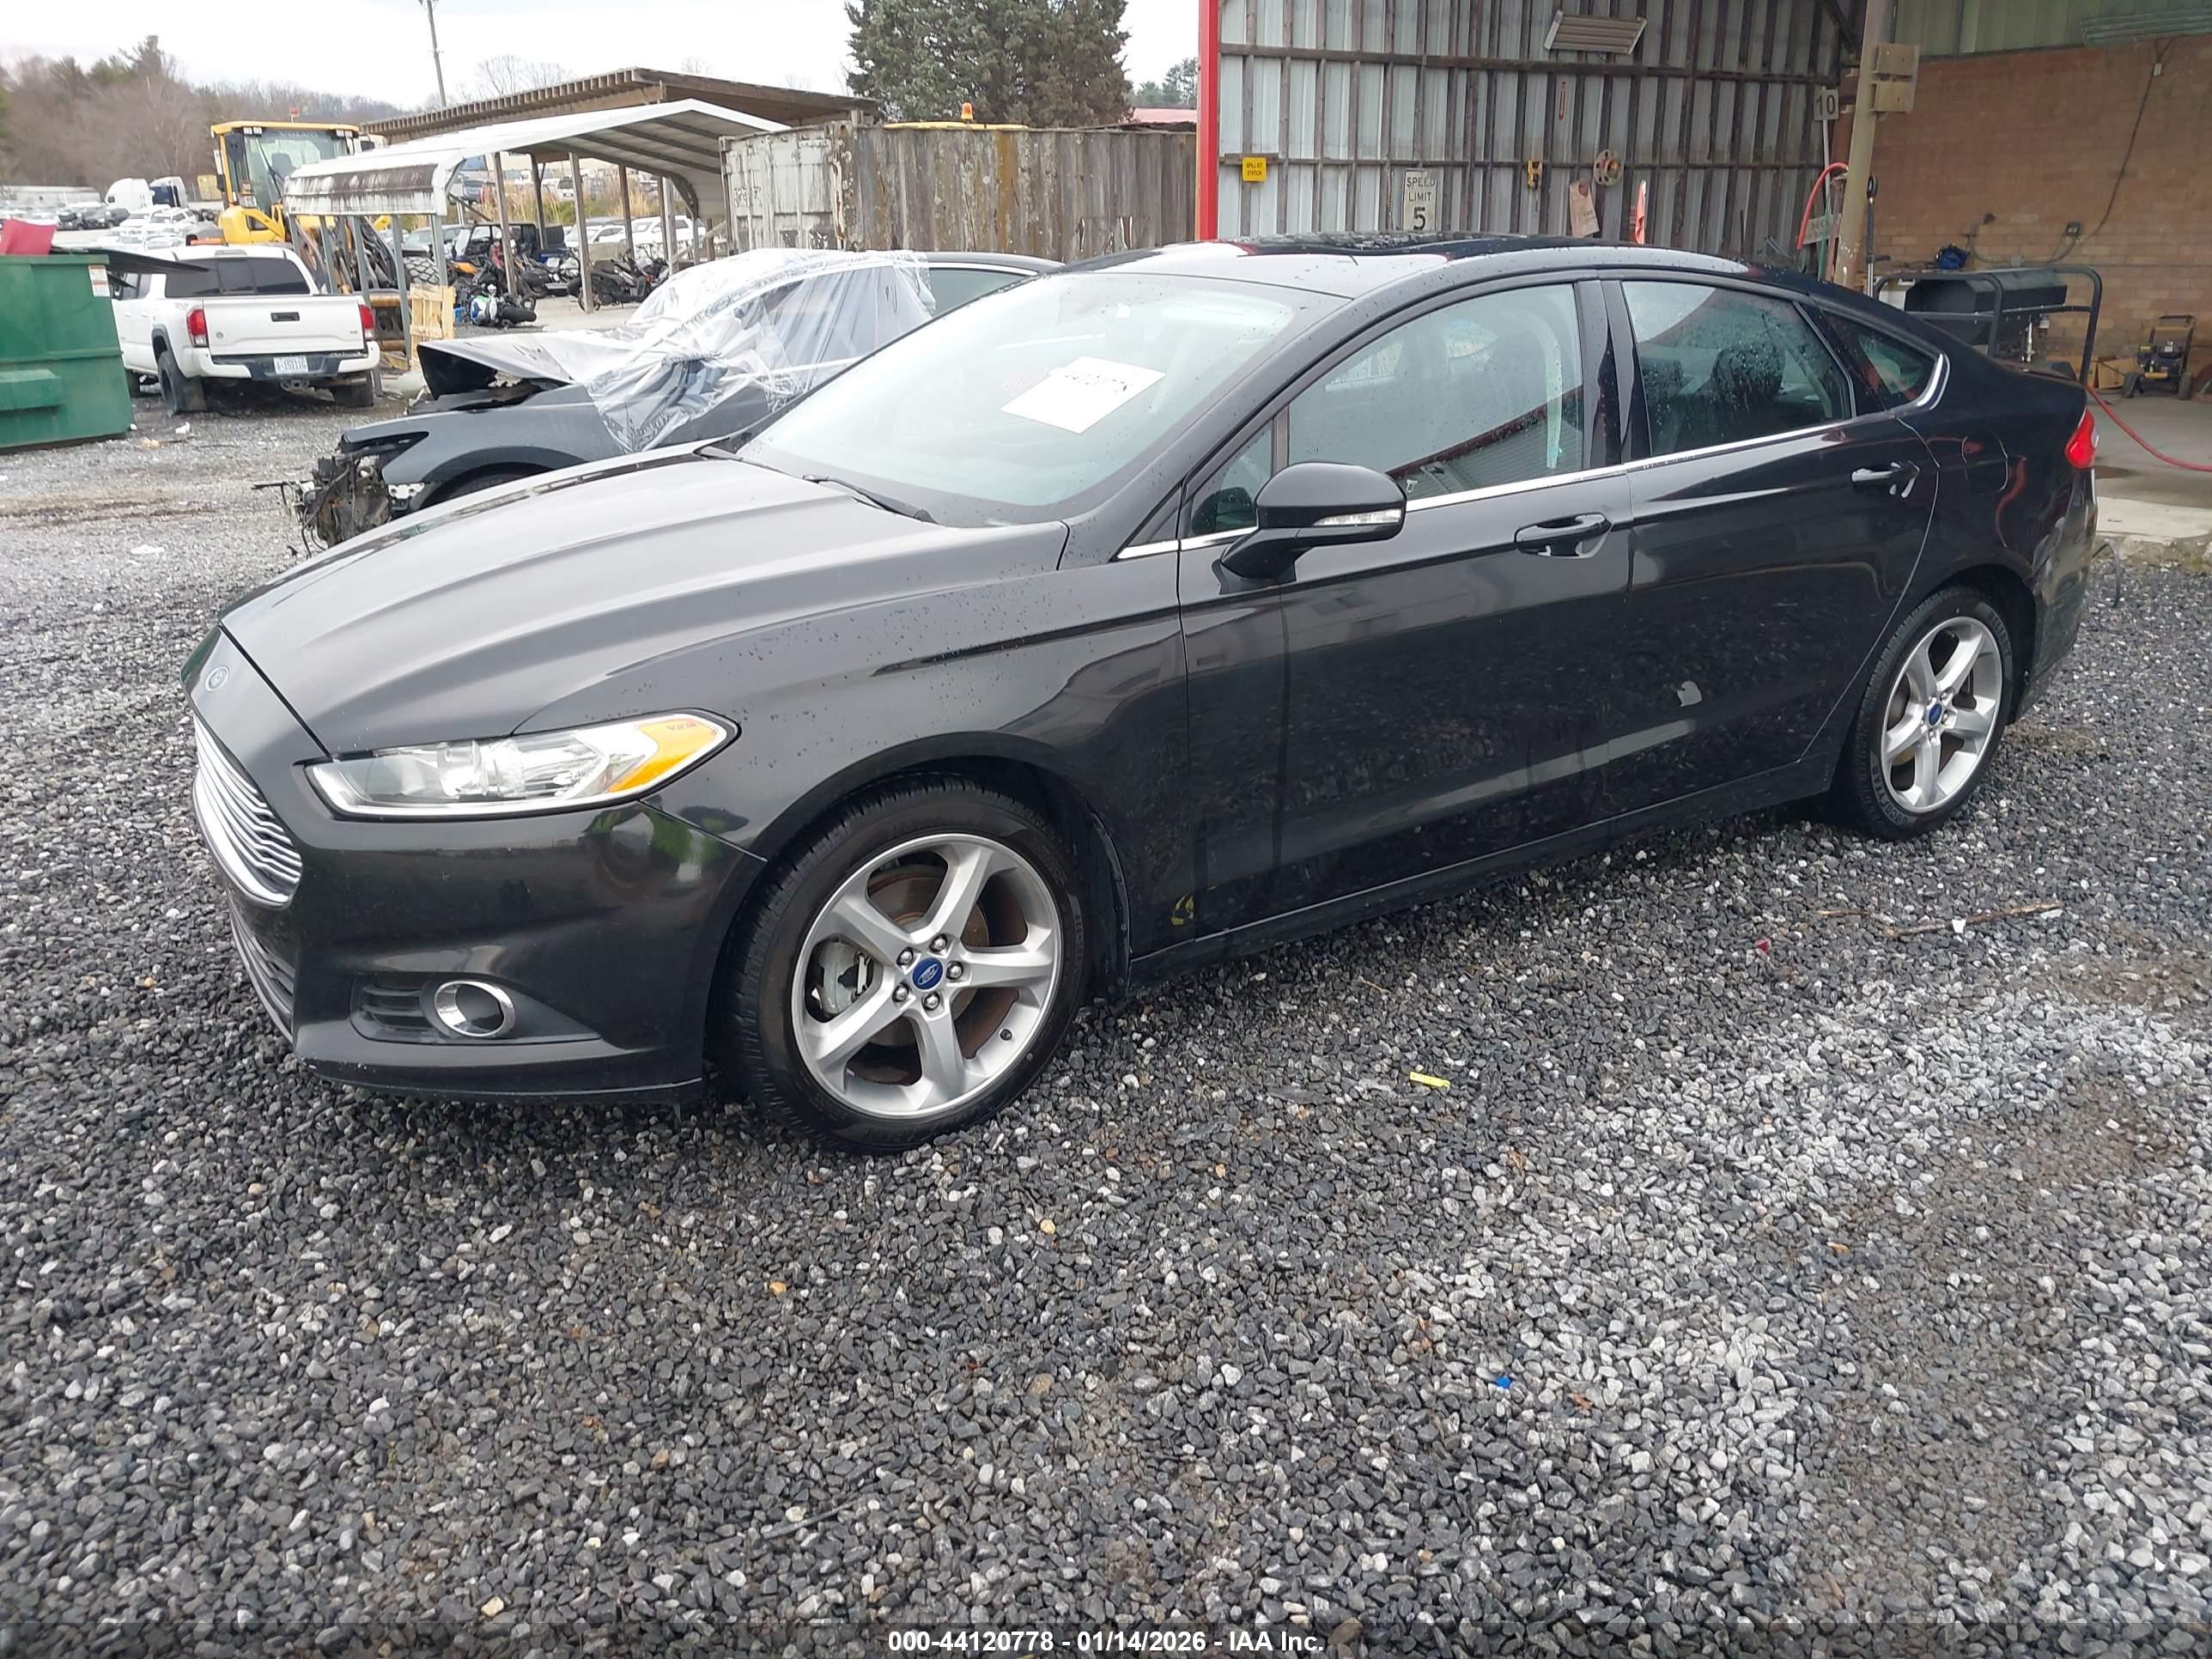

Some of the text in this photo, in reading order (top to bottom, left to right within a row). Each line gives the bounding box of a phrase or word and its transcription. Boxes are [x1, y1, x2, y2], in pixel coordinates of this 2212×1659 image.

[1815, 94, 1836, 116] 10
[1407, 177, 1436, 187] SPEED
[1408, 191, 1432, 202] LIMIT
[1413, 206, 1425, 231] 5
[1873, 766, 1908, 823] GOODYEAR
